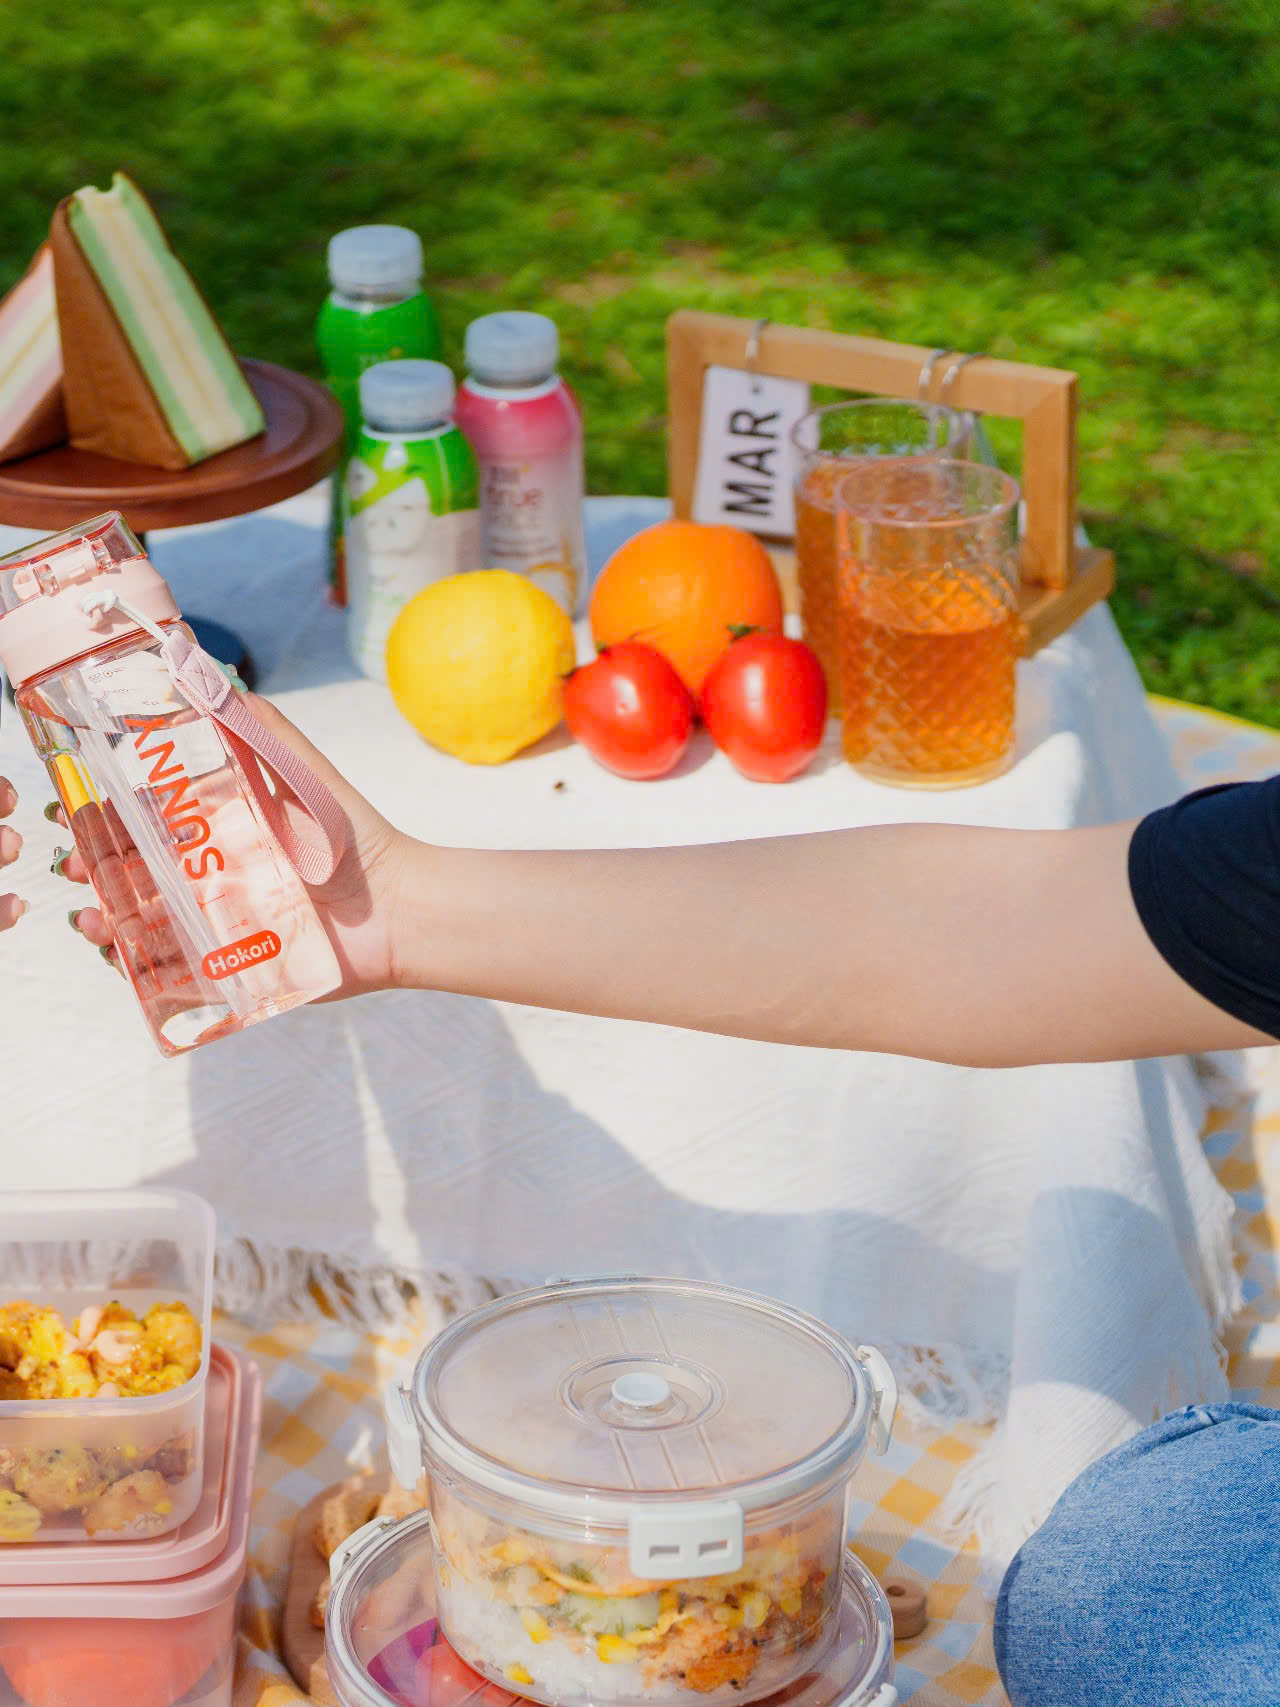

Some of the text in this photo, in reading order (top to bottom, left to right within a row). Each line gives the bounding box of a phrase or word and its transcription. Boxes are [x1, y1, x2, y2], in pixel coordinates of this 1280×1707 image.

[723, 410, 780, 517] MAR
[124, 717, 225, 880] SUNNY
[208, 935, 276, 975] Hokori
